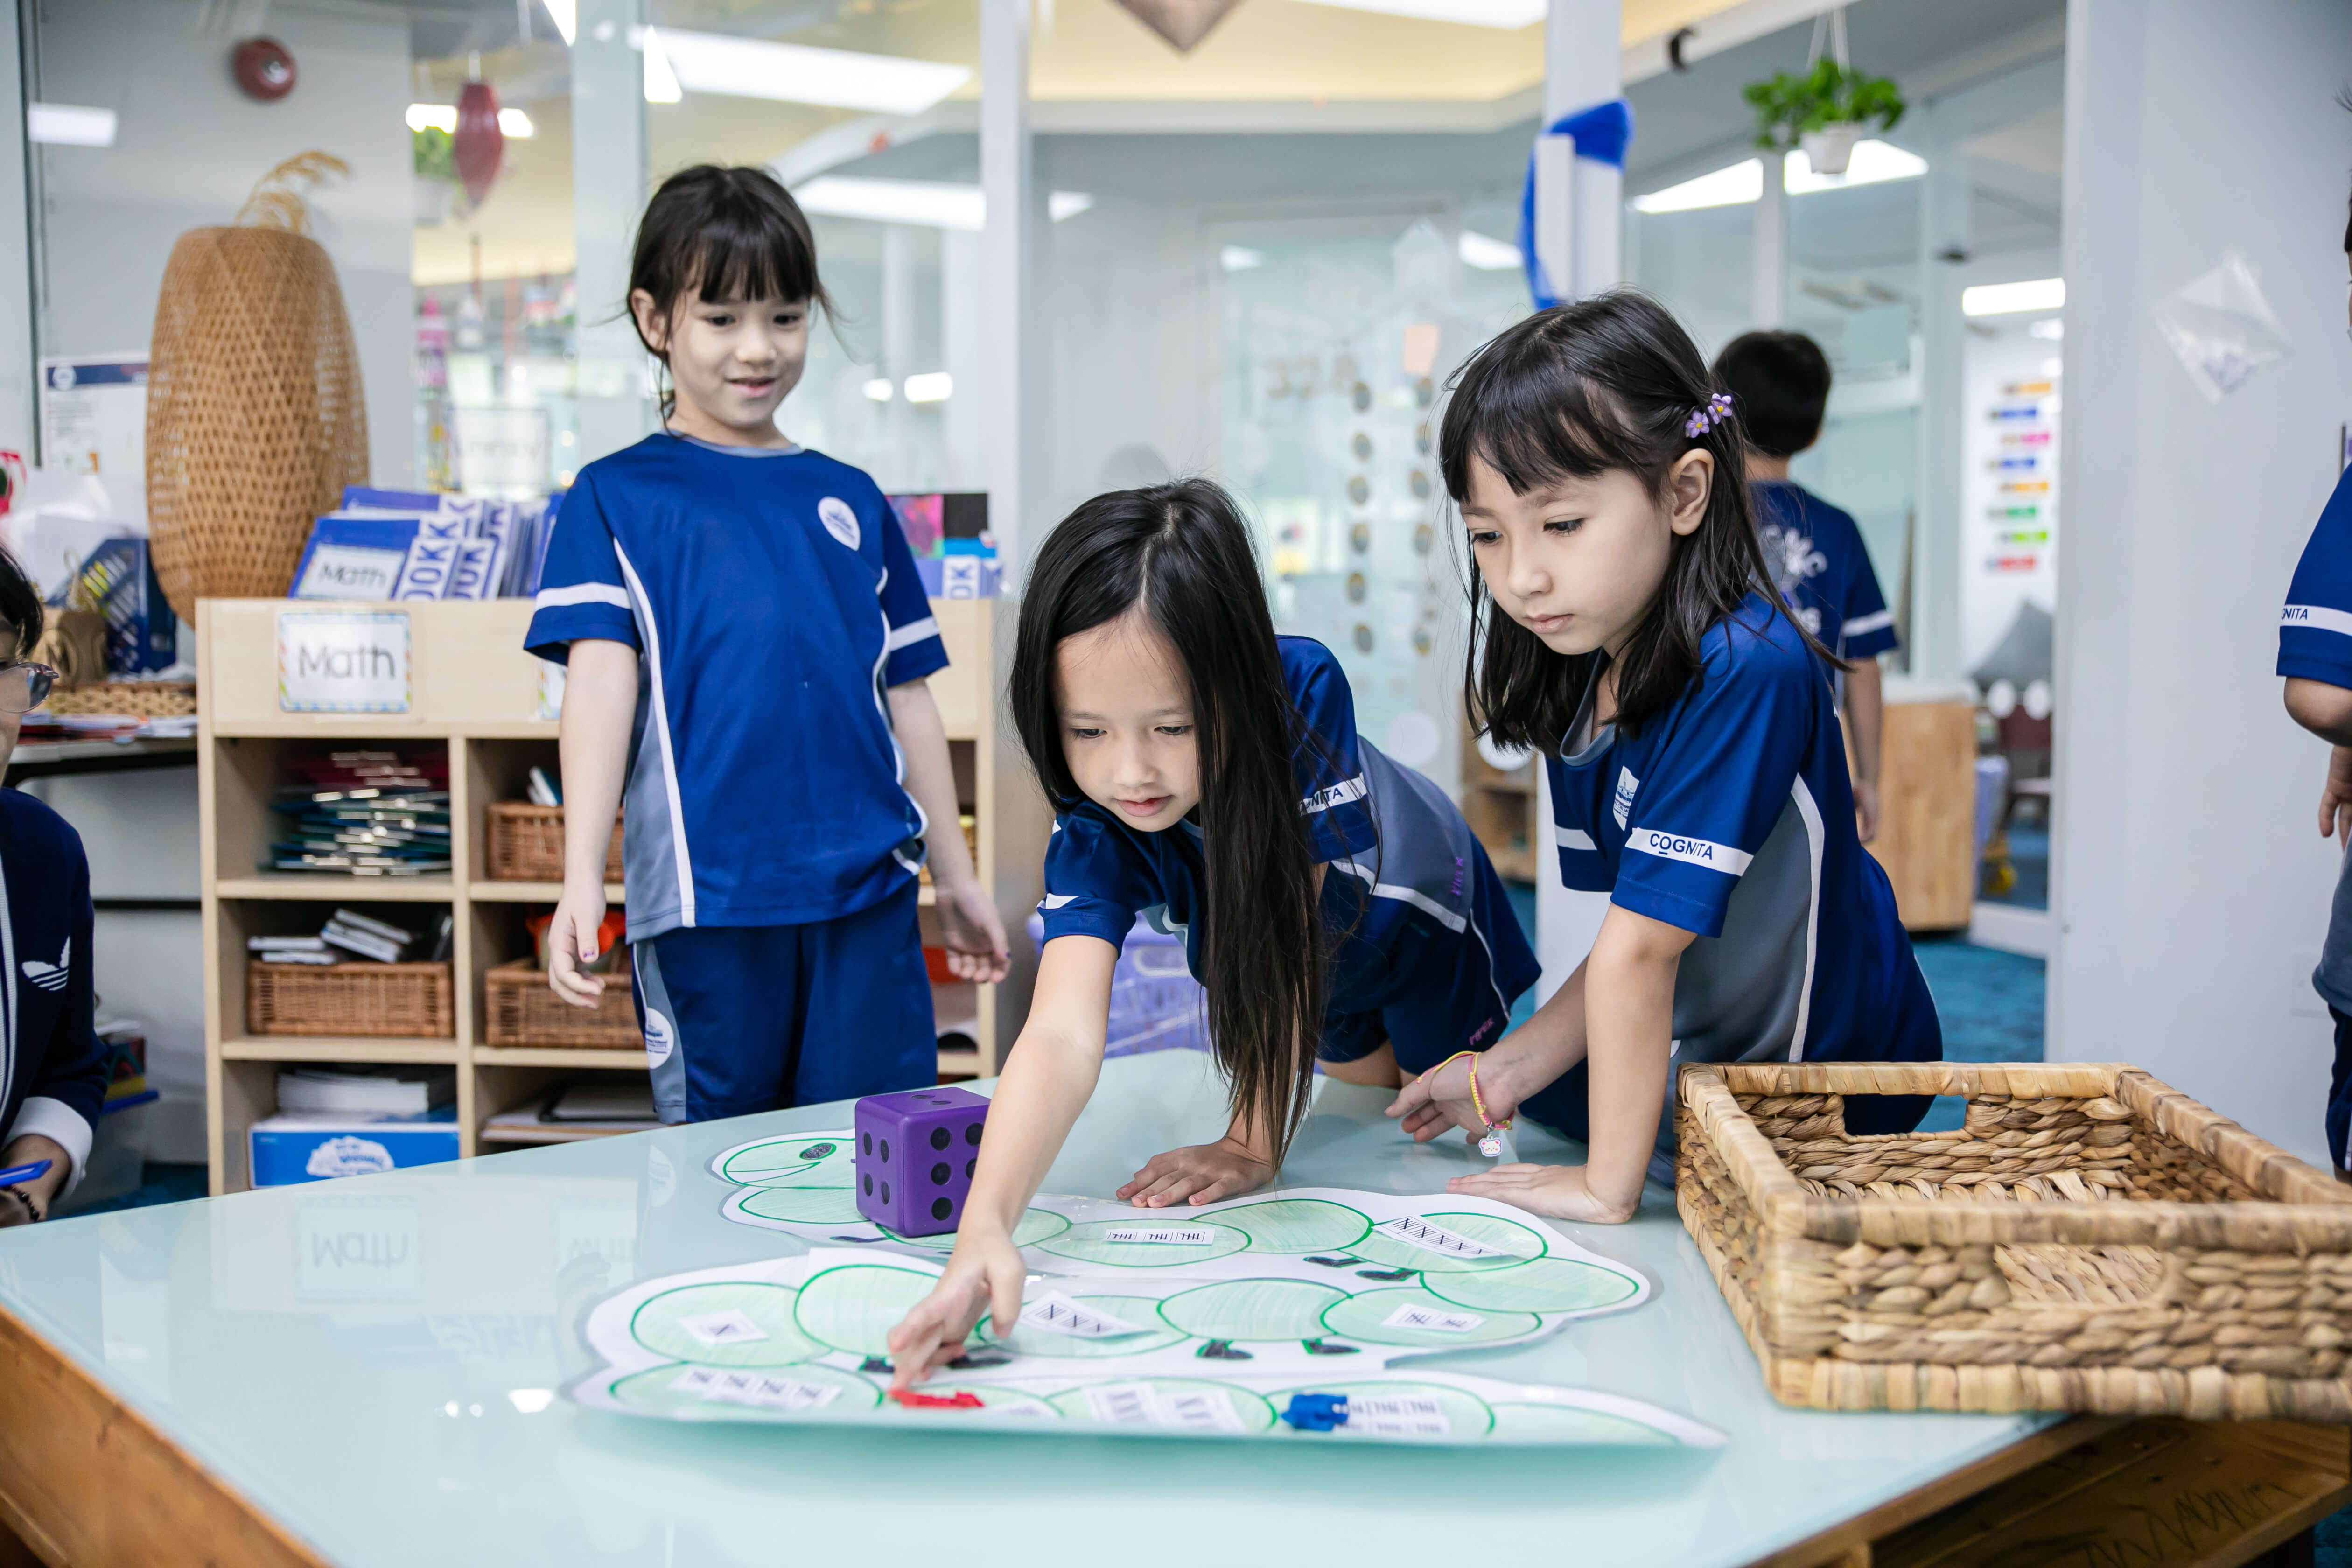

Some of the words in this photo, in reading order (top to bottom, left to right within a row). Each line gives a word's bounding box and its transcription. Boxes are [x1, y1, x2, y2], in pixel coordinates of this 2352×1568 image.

[318, 563, 387, 588] Math
[299, 645, 395, 679] Math
[1650, 833, 1712, 860] COGNITA
